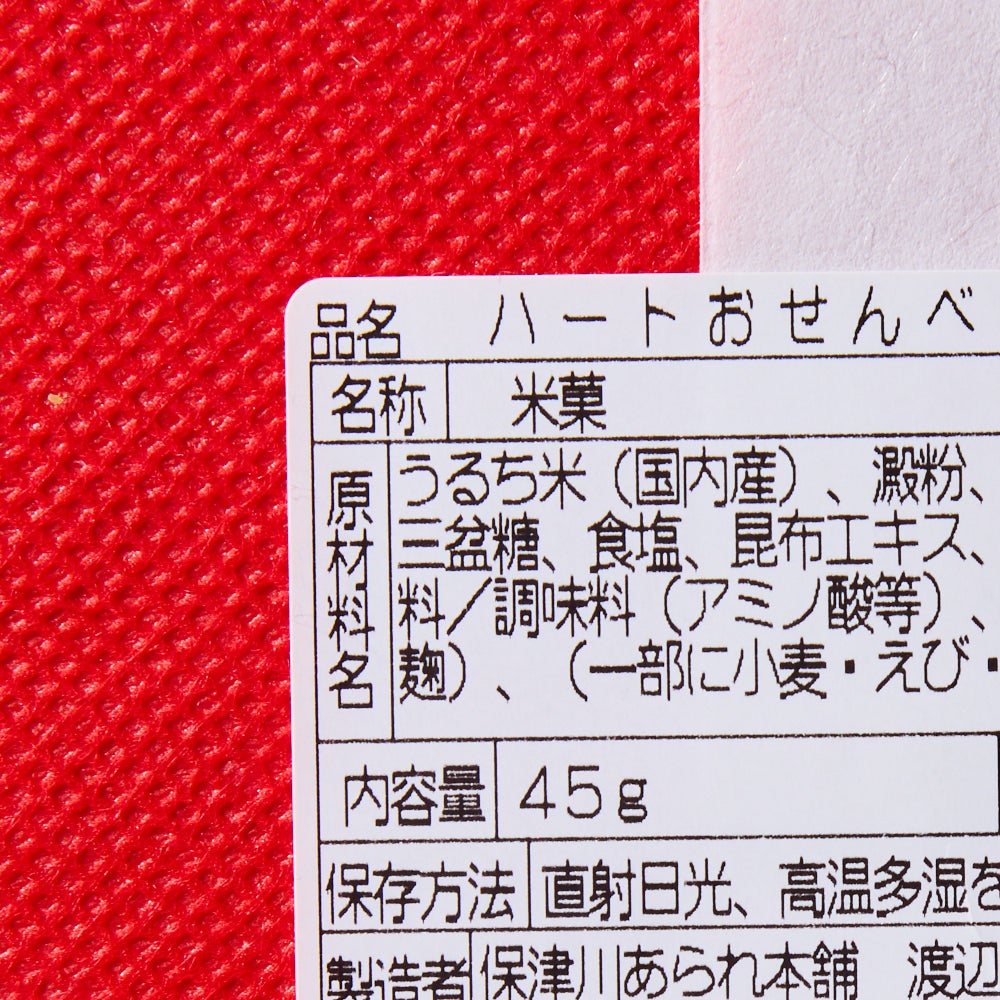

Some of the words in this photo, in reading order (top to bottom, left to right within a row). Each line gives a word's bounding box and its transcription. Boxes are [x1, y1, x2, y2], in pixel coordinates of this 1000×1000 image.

[310, 302, 402, 362] 品名
[332, 374, 426, 436] 名称
[512, 371, 606, 432] 米菓
[327, 471, 375, 709] 原材料名
[345, 764, 485, 827] 内容量
[520, 766, 647, 823] 45g
[326, 861, 515, 924] 保存方法
